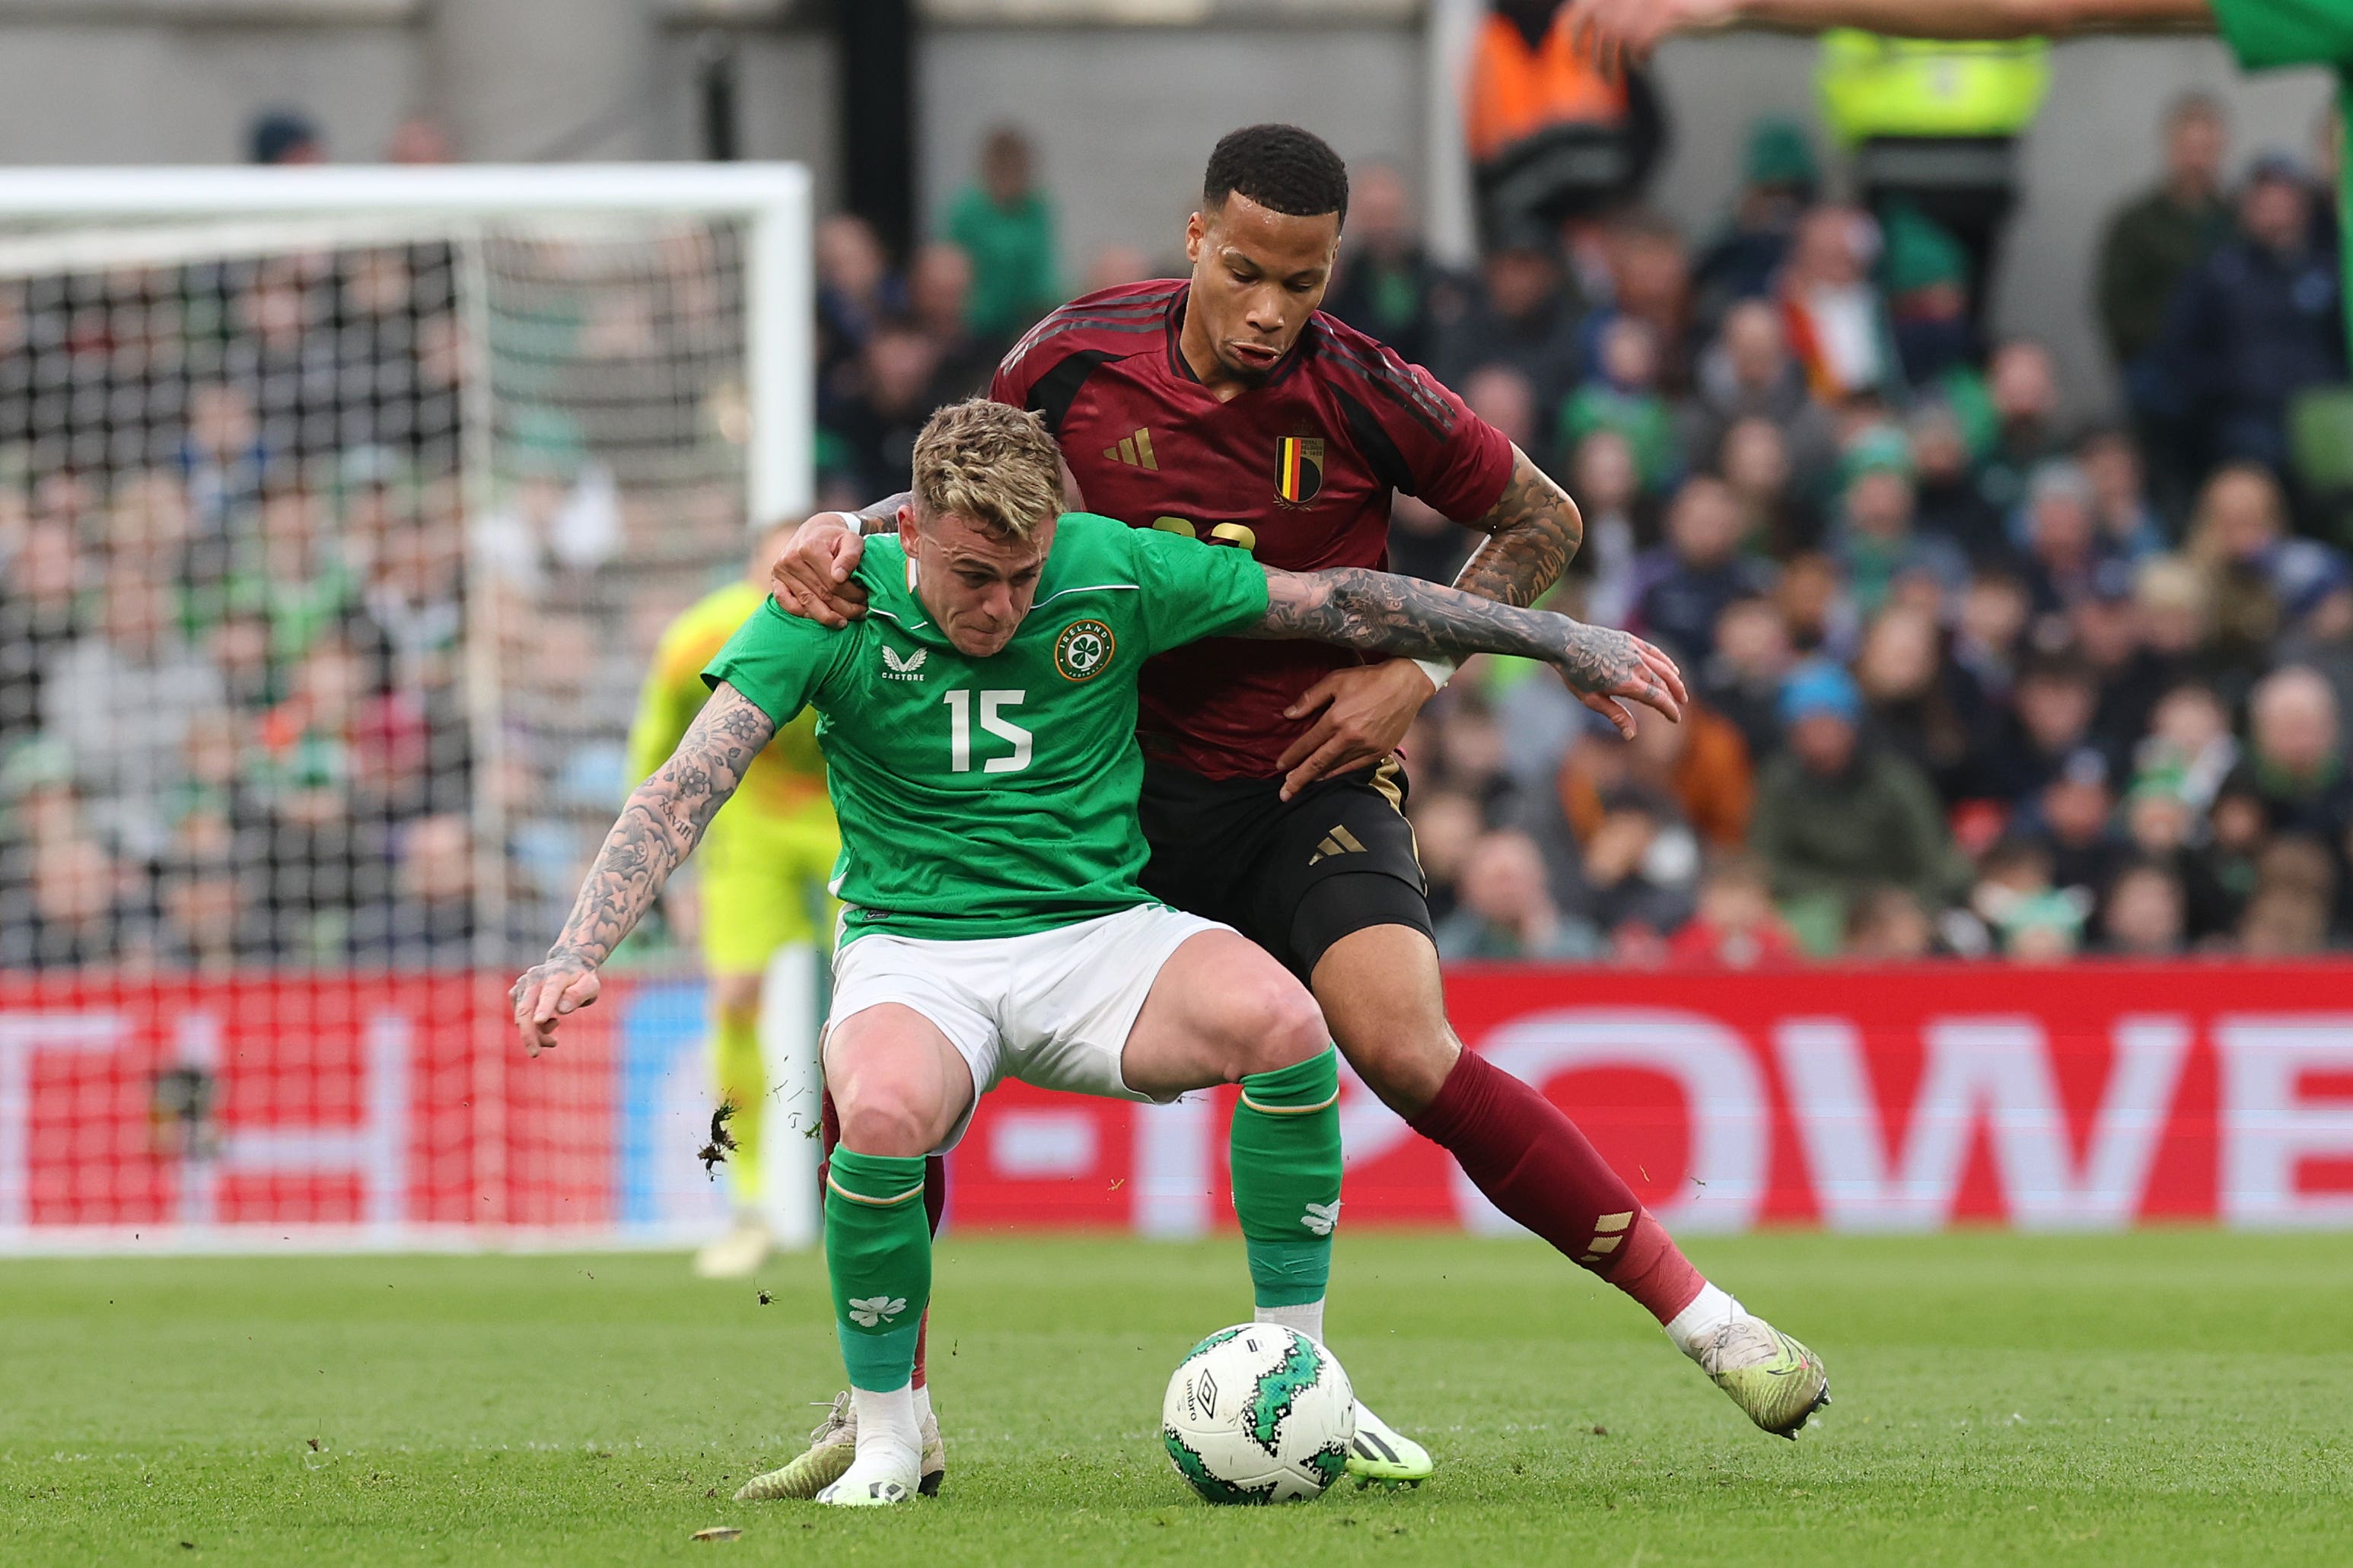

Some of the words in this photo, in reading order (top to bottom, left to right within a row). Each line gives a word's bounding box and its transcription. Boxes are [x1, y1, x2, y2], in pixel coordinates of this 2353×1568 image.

[1059, 623, 1108, 649] IRELAND
[881, 672, 925, 682] CASTORE
[943, 689, 1033, 773] 15
[1186, 1379, 1197, 1421] umbro
